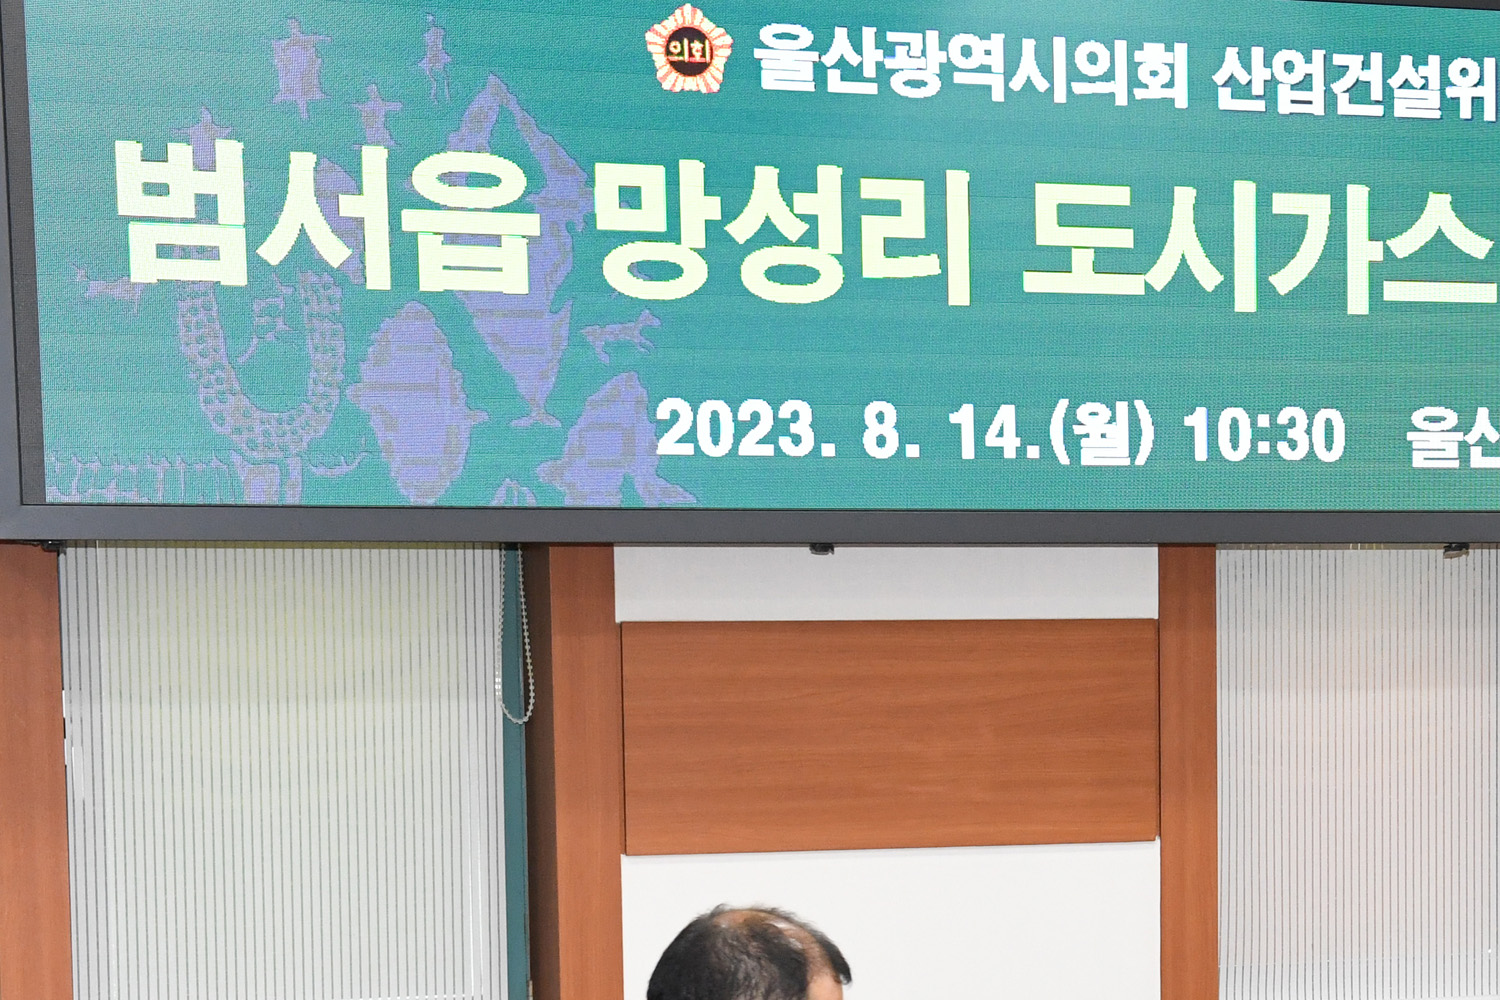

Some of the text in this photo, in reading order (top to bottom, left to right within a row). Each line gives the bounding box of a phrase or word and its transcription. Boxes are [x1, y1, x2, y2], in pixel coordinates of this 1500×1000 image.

[668, 37, 711, 64] 의회
[754, 22, 1189, 109] 울산광역시의회
[113, 134, 541, 295] 범서읍
[594, 159, 971, 307] 망성리
[1023, 179, 1498, 315] 도시가스
[655, 397, 837, 459] 2023.
[861, 399, 920, 460] 8.
[948, 397, 1155, 467] 14.(월)
[1182, 405, 1347, 464] 10:30
